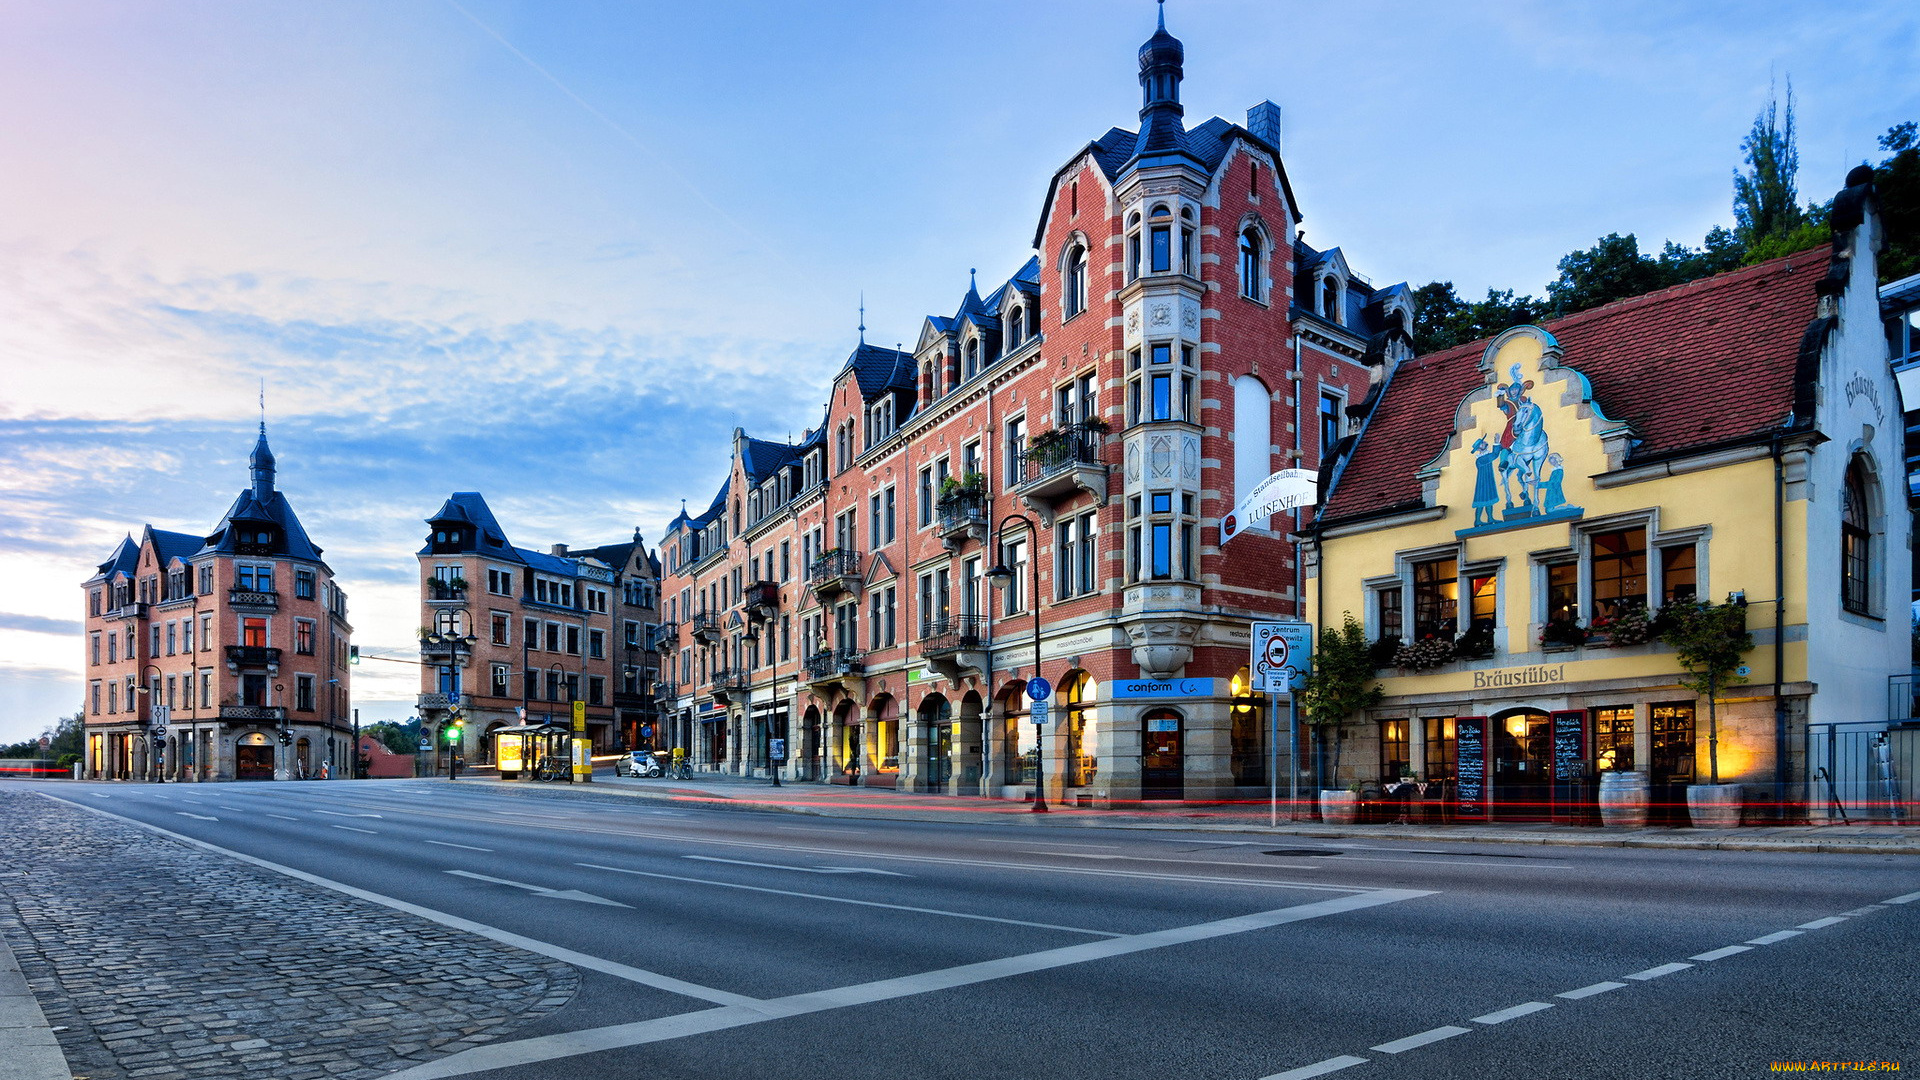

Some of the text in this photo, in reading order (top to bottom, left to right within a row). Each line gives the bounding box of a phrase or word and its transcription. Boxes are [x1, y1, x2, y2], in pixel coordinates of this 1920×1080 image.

[1253, 470, 1302, 497] Standseilbahn
[1248, 491, 1309, 524] LUISENHOF
[1127, 682, 1172, 693] conform
[1473, 665, 1565, 688] Bräustübel
